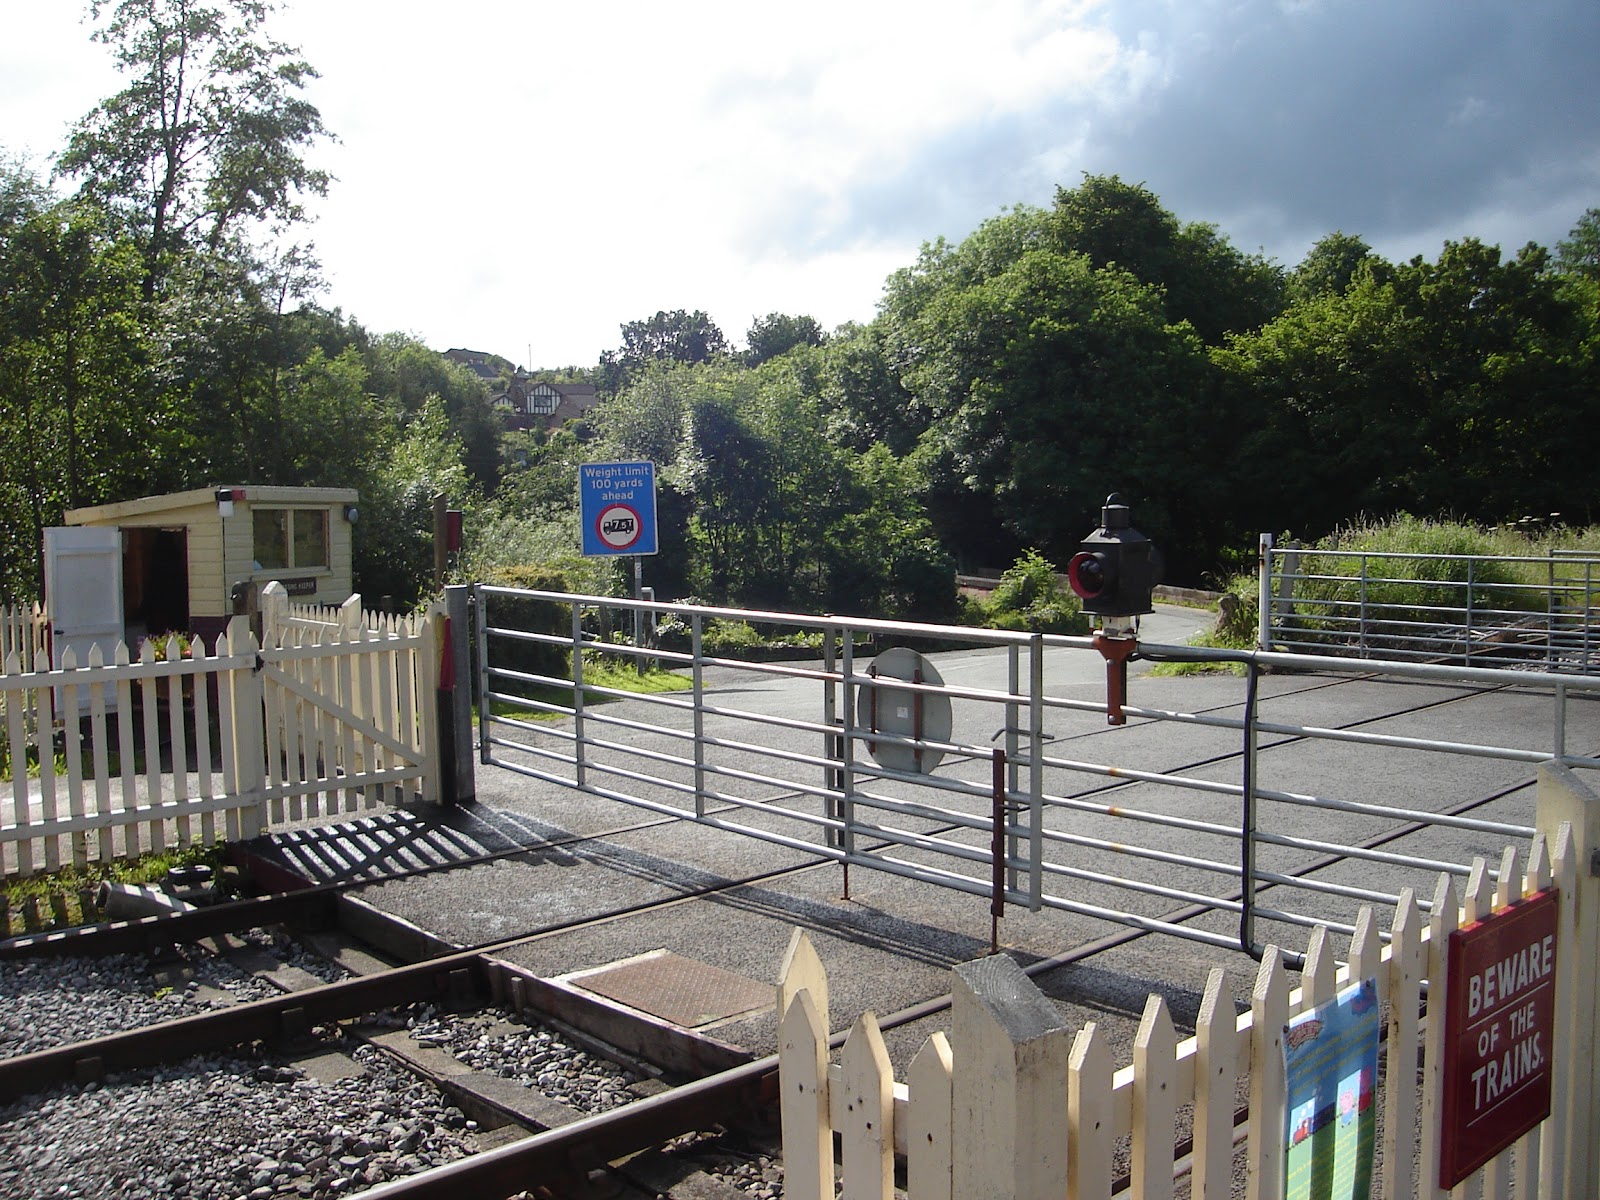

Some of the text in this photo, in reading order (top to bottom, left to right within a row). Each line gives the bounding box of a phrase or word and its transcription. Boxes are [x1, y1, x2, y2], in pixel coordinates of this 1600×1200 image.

[585, 466, 649, 478] Weight limit
[592, 478, 643, 490] 100 yards
[602, 490, 634, 500] ahead
[1468, 935, 1553, 1018] BEWARE
[1478, 1001, 1535, 1058] OF THE
[1471, 1031, 1544, 1110] TRAINS.
